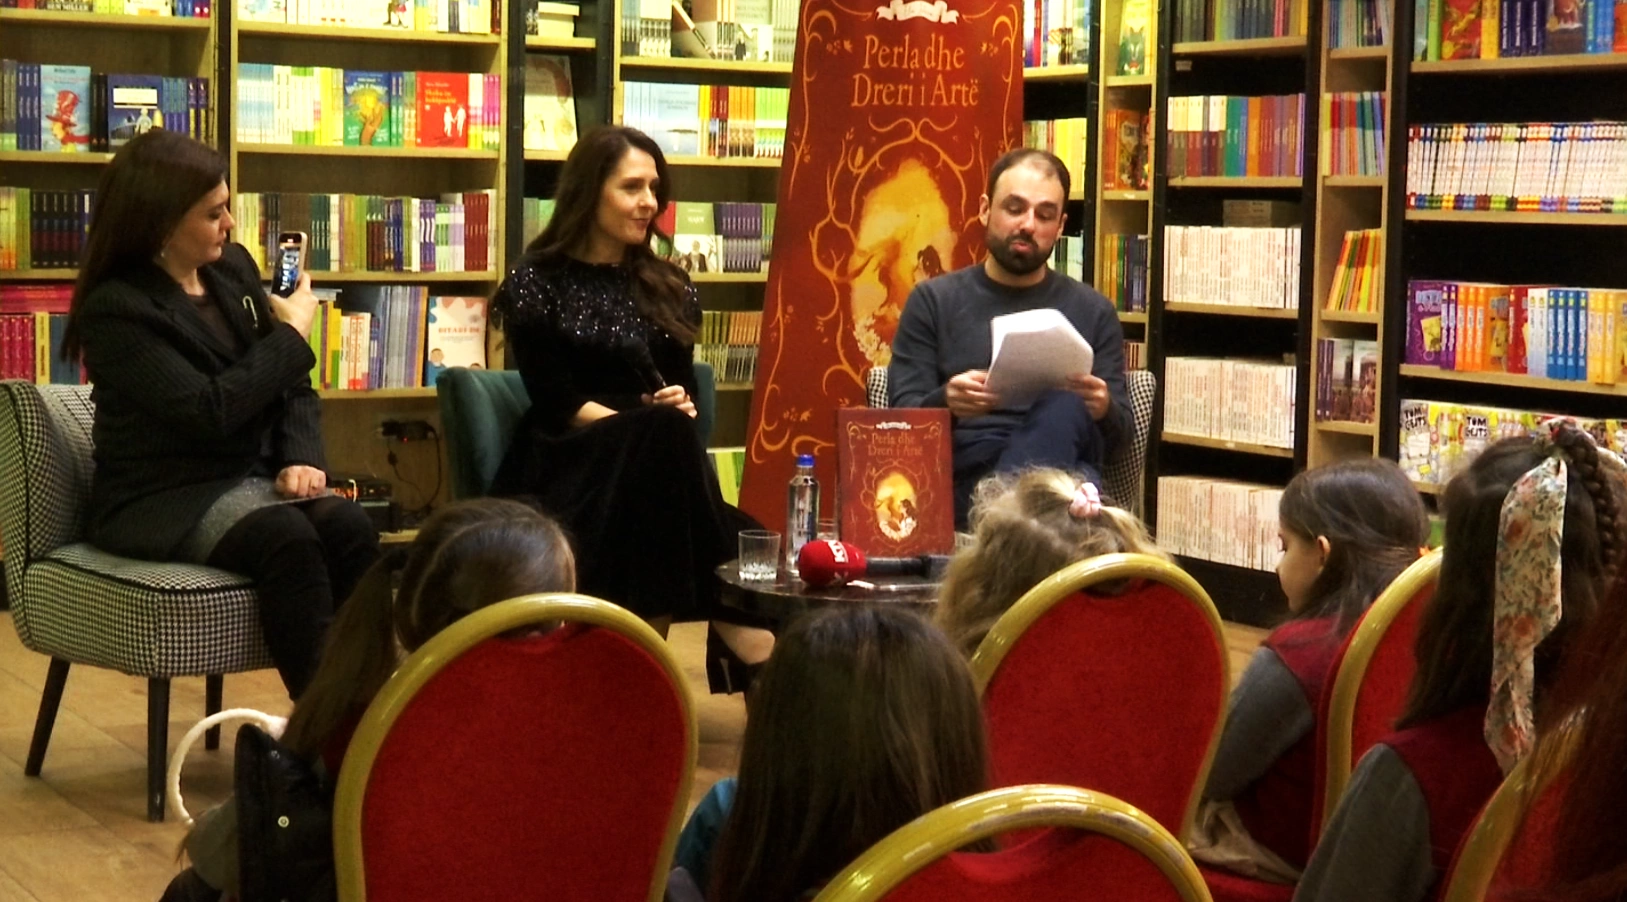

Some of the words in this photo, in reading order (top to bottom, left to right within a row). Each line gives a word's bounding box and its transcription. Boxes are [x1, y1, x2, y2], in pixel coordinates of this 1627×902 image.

[863, 33, 920, 69] Perla
[924, 32, 965, 71] dhe
[851, 71, 914, 107] Dreri
[919, 72, 926, 106] i
[930, 73, 979, 107] Artë
[1404, 406, 1423, 419] TOM
[1466, 416, 1487, 427] TOM
[871, 432, 896, 445] Perla
[898, 431, 915, 445] dhe
